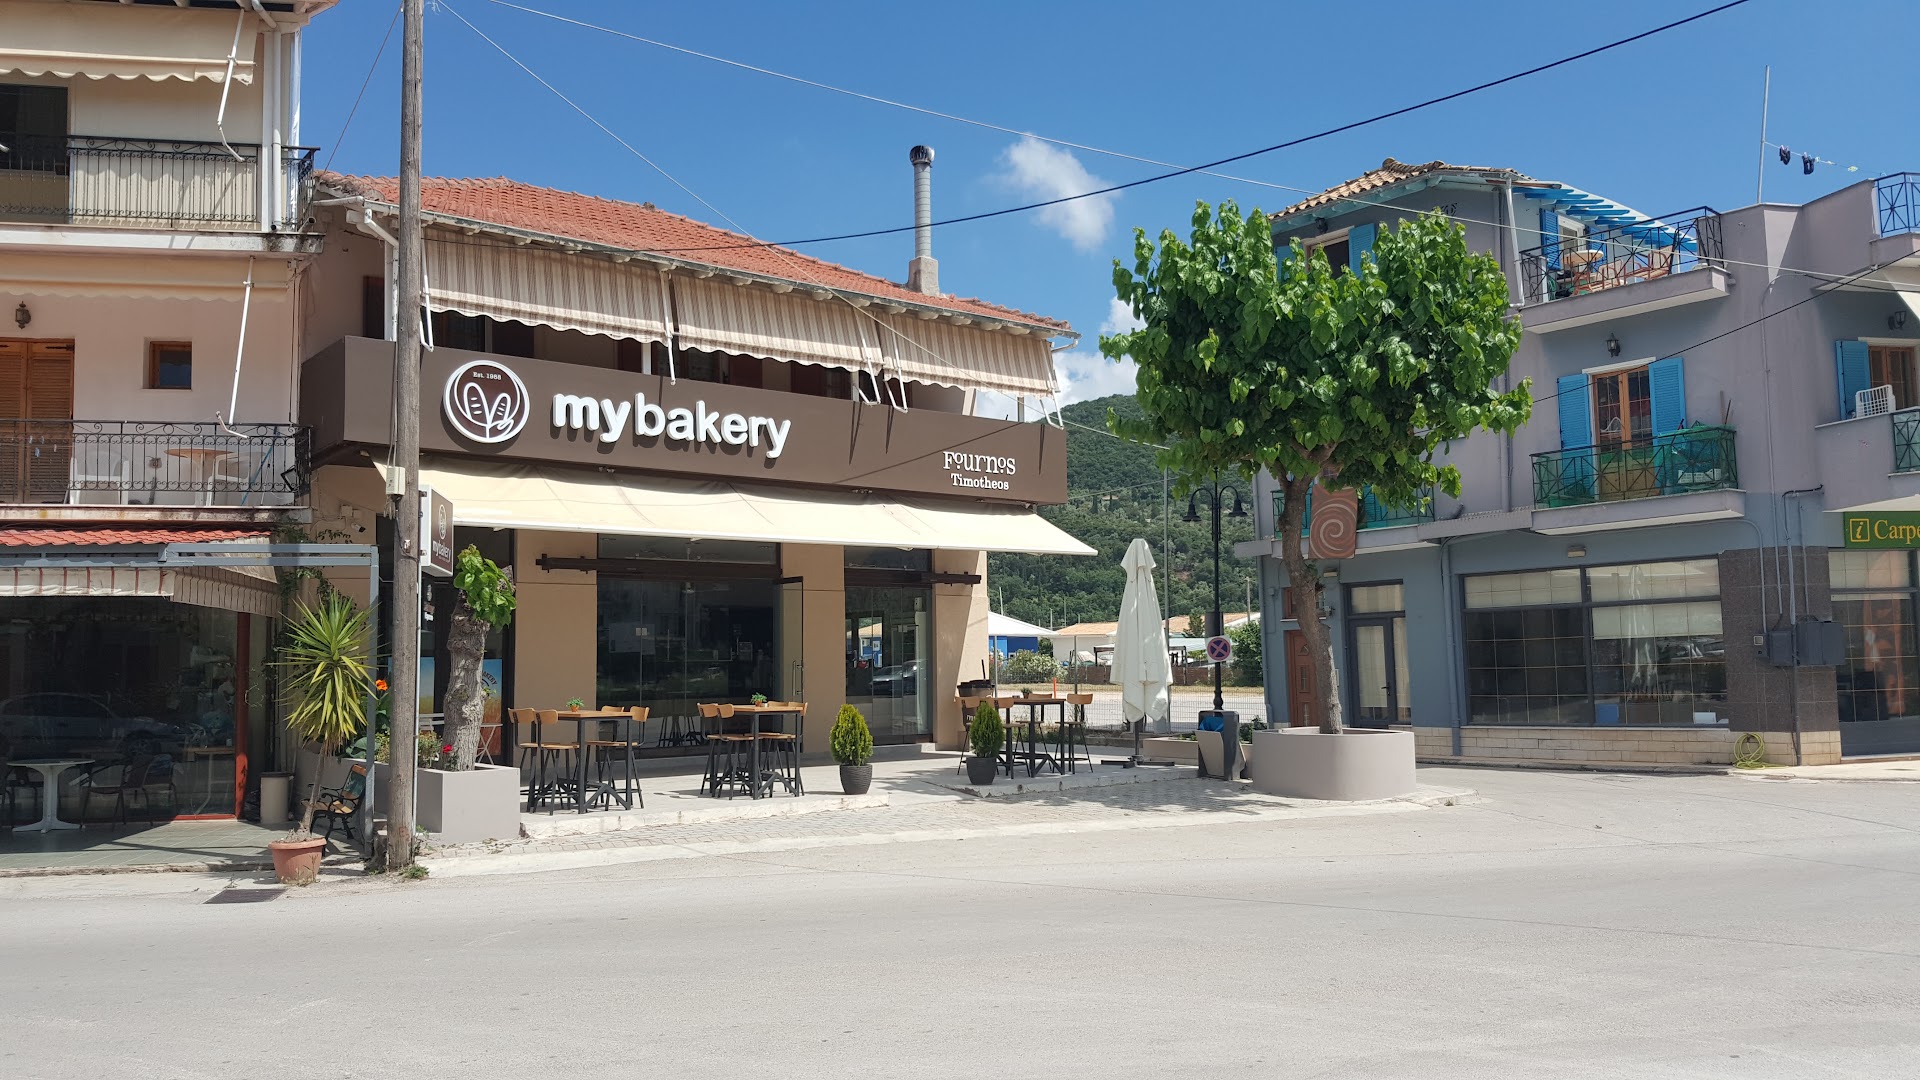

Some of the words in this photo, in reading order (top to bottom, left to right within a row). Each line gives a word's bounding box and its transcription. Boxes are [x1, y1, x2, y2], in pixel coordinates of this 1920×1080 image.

[553, 392, 791, 458] mybakery
[943, 451, 1016, 474] Fournos
[951, 473, 1009, 490] Timotheos
